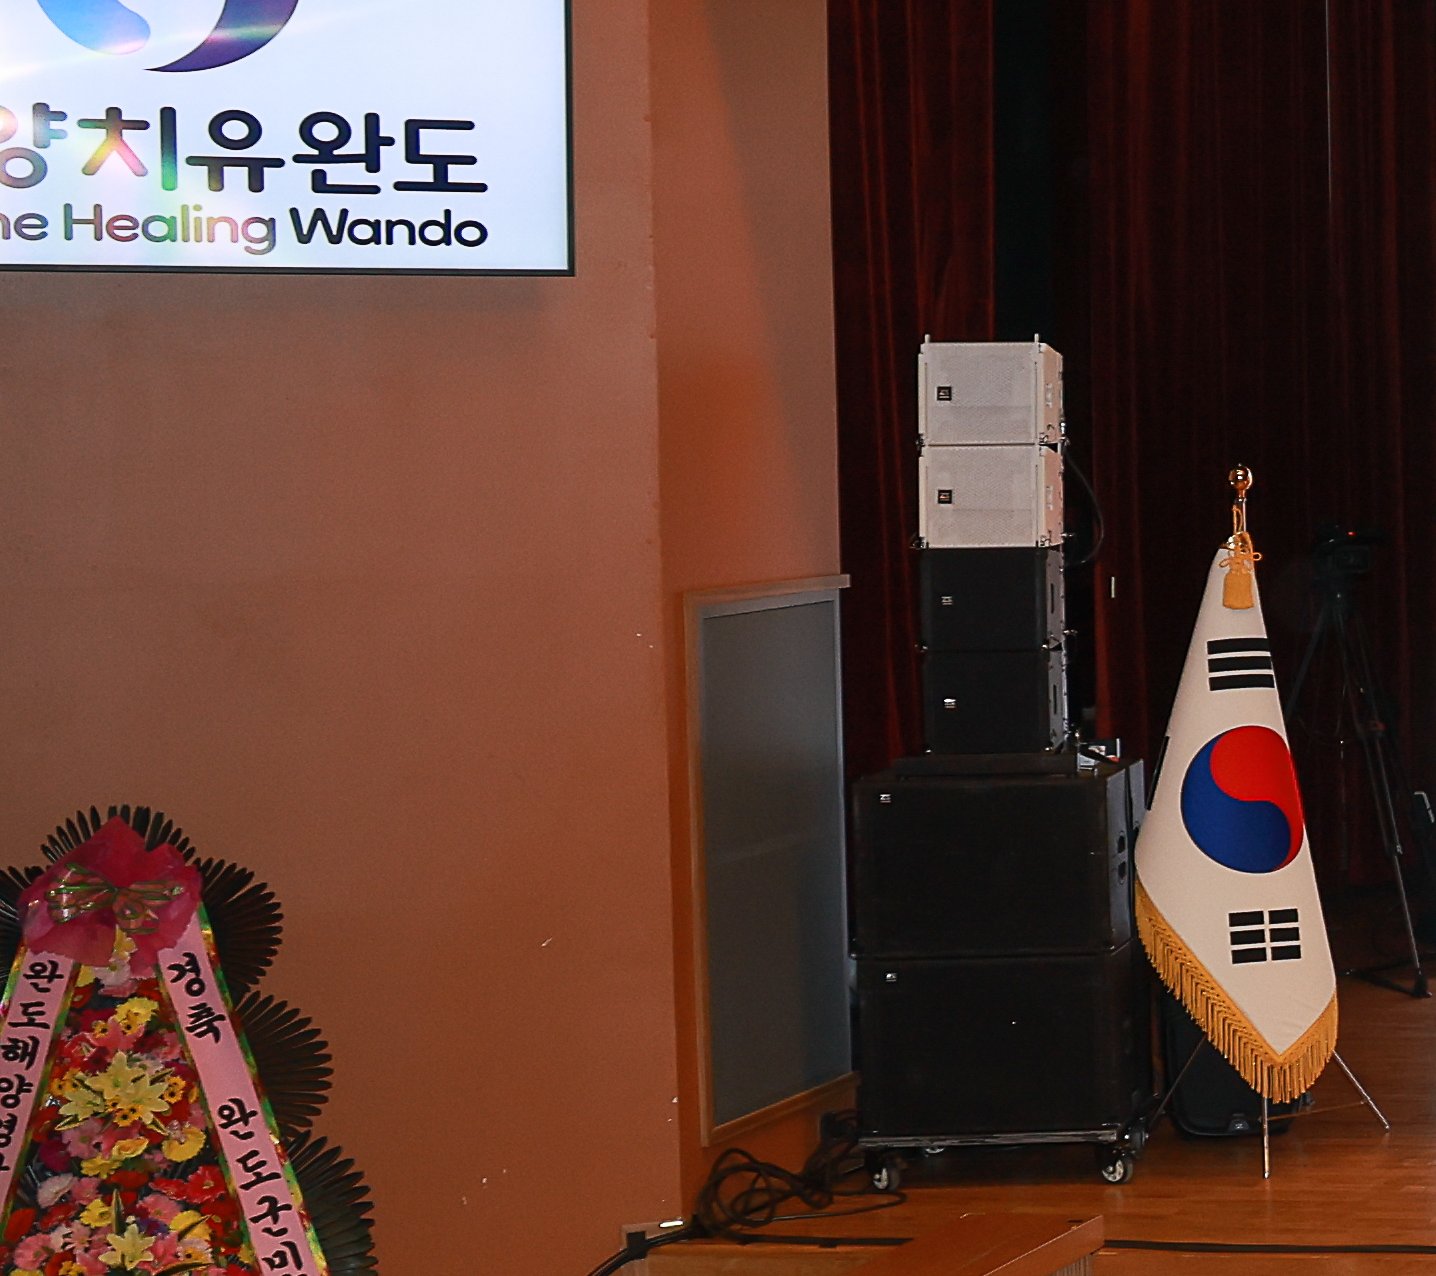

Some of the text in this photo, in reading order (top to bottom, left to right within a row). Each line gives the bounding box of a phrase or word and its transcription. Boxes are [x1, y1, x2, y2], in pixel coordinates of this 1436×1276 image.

[63, 203, 276, 255] Healing
[289, 207, 488, 248] Wando
[168, 952, 227, 1044] 경축
